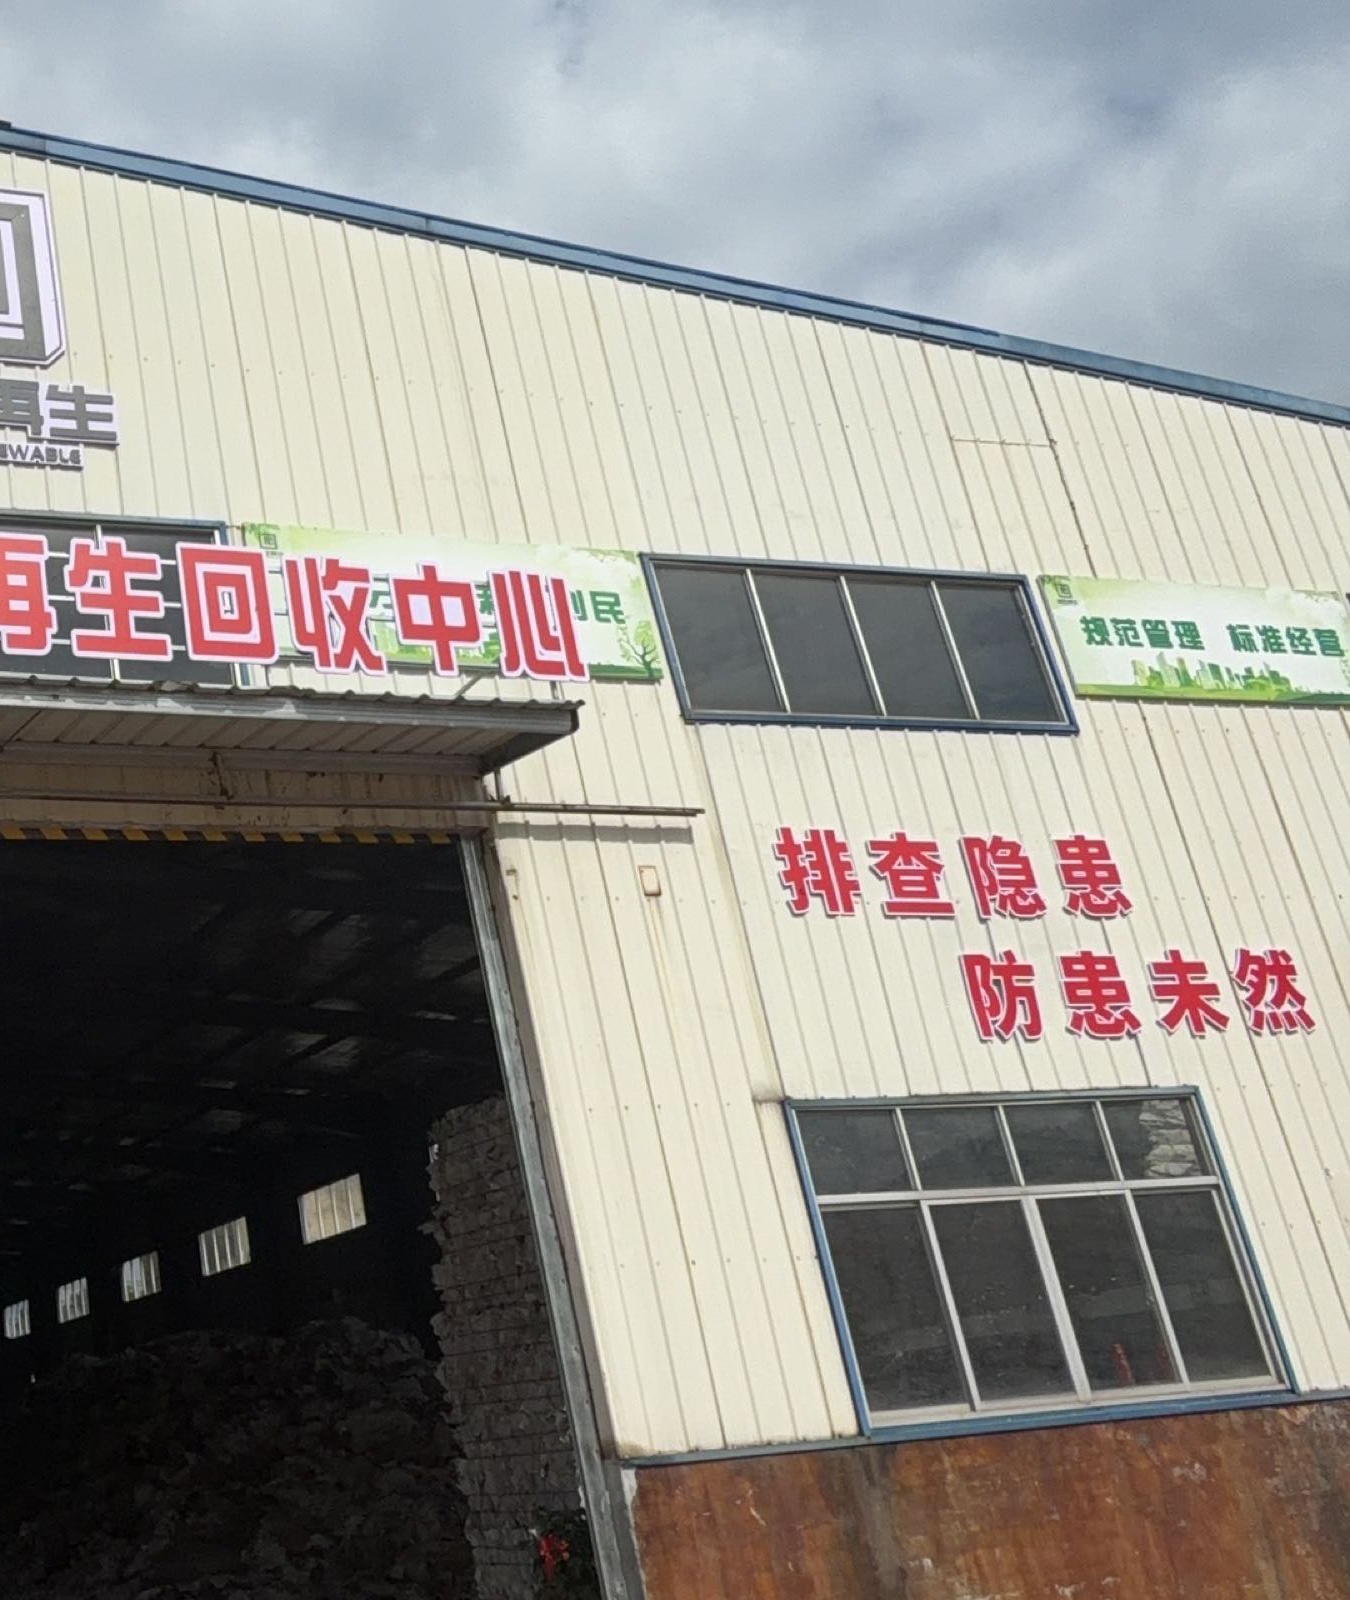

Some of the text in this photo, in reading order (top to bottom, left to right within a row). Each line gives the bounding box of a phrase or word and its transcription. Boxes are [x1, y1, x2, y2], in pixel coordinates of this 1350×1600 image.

[1079, 615, 1345, 657] 规范管理 标准经营
[772, 826, 1132, 919] 排查隐患
[960, 948, 1316, 1039] 防患未然
